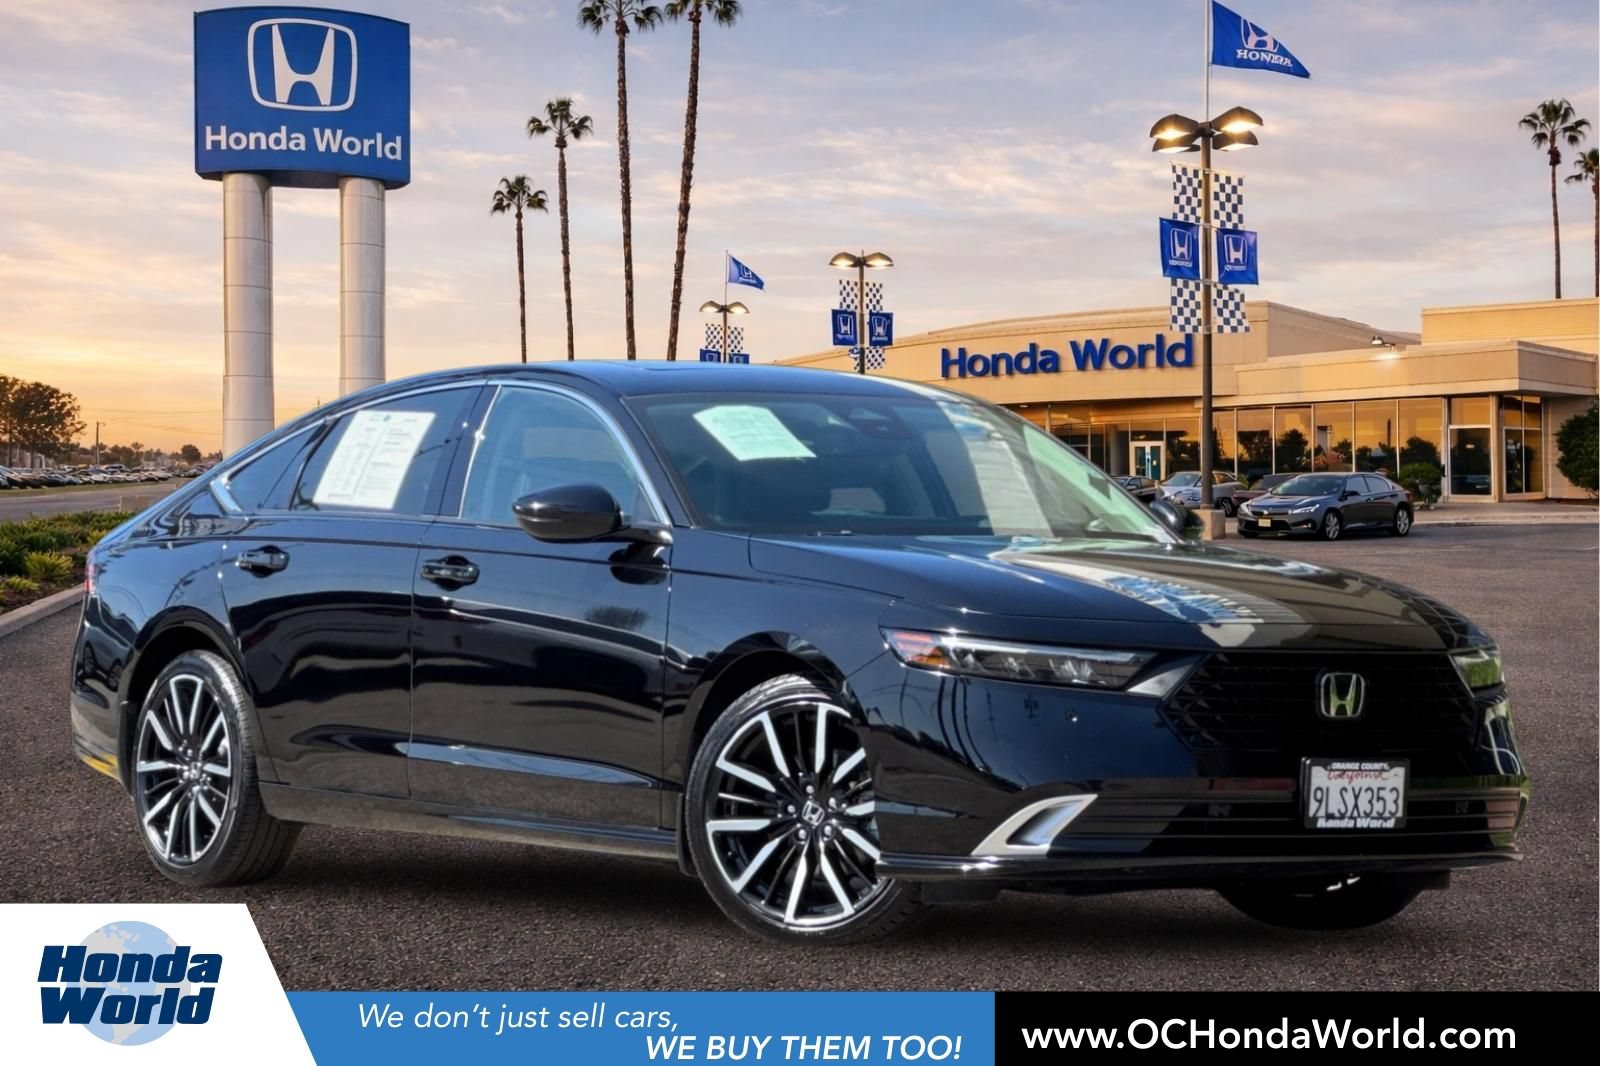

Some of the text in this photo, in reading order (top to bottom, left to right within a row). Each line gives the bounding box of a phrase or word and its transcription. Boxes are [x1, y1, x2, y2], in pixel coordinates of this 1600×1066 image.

[205, 125, 402, 160] Honda World
[940, 333, 1194, 378] Honda World
[1313, 787, 1400, 818] 9LSX353
[1317, 818, 1355, 828] Honda
